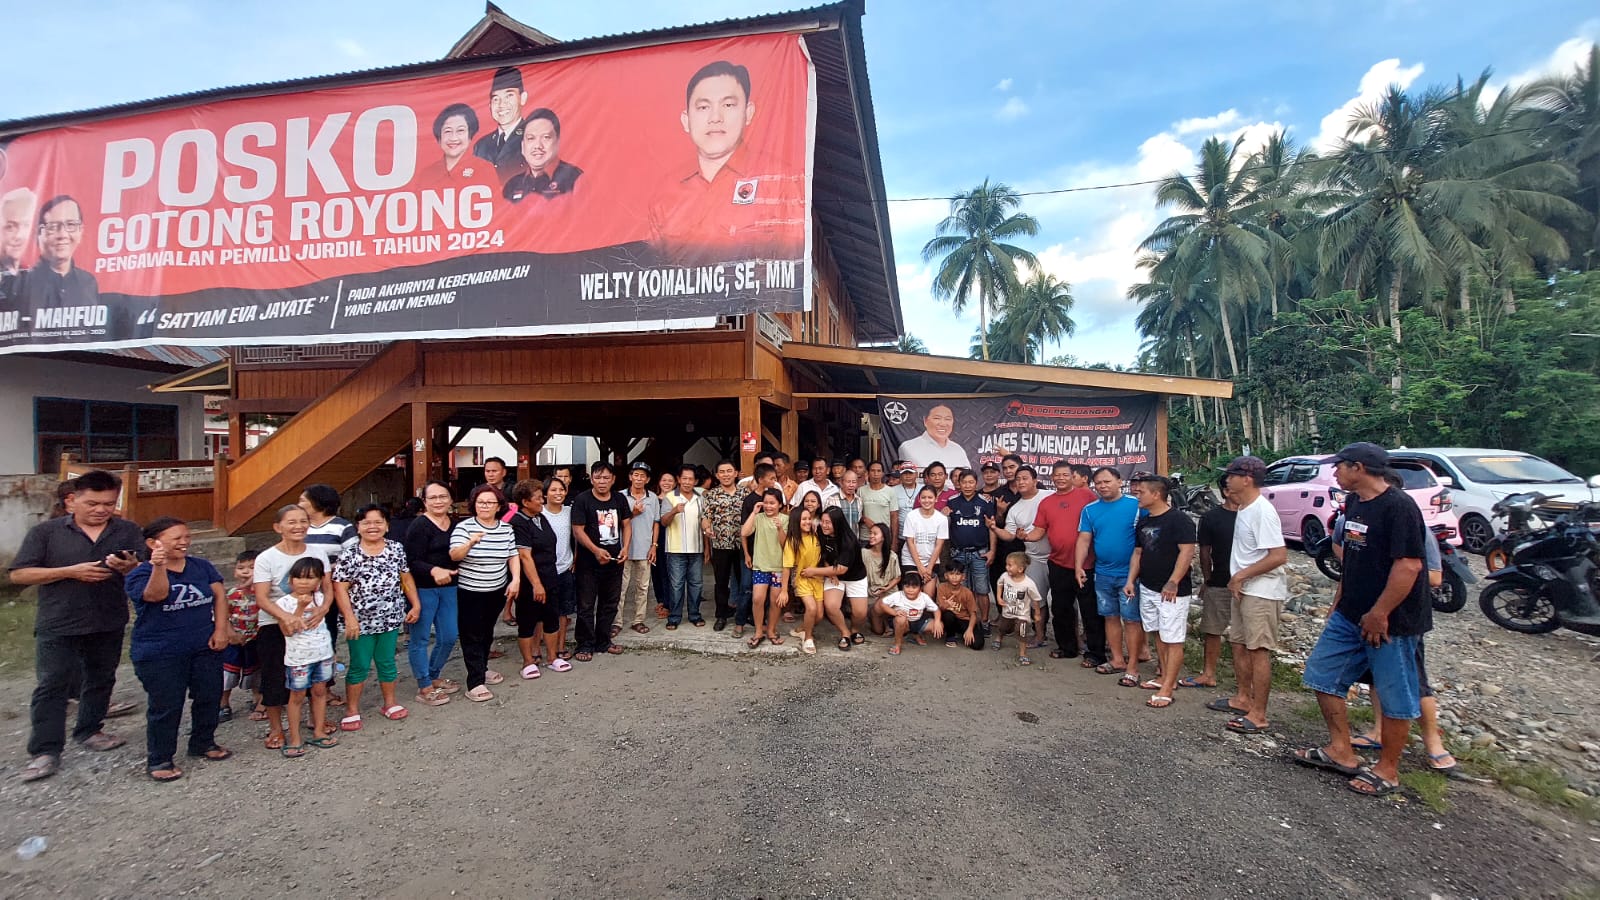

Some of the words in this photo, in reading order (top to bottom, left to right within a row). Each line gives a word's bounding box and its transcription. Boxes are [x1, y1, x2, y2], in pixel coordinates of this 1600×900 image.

[100, 104, 418, 214] POSKO
[97, 204, 274, 255] GOTONG
[289, 184, 494, 241] ROYONG
[95, 250, 215, 273] PENGAWALAN
[220, 245, 291, 265] PEMILU
[296, 240, 366, 261] JURDIL
[373, 234, 441, 256] TAHUN
[447, 229, 505, 251] 2024
[348, 286, 376, 301] PADA
[378, 278, 435, 297] AKHIRNYA
[437, 265, 530, 289] KEBENARANLAH
[580, 272, 634, 300] WELTY
[637, 265, 730, 297] KOMALING,
[734, 261, 760, 295] SE,
[765, 260, 796, 289] MM
[34, 305, 108, 329] MAHFUD
[228, 305, 258, 324] EVA
[344, 303, 371, 317] YANG
[373, 298, 403, 313] AKAN
[406, 291, 456, 309] MENANG
[977, 432, 1018, 454] JAMES
[1021, 432, 1091, 457] SUMENDAP,
[1096, 435, 1120, 457] S.H.,
[1125, 432, 1147, 453] M.H.
[1067, 457, 1116, 466] SULAWESI
[956, 517, 980, 528] Jeep
